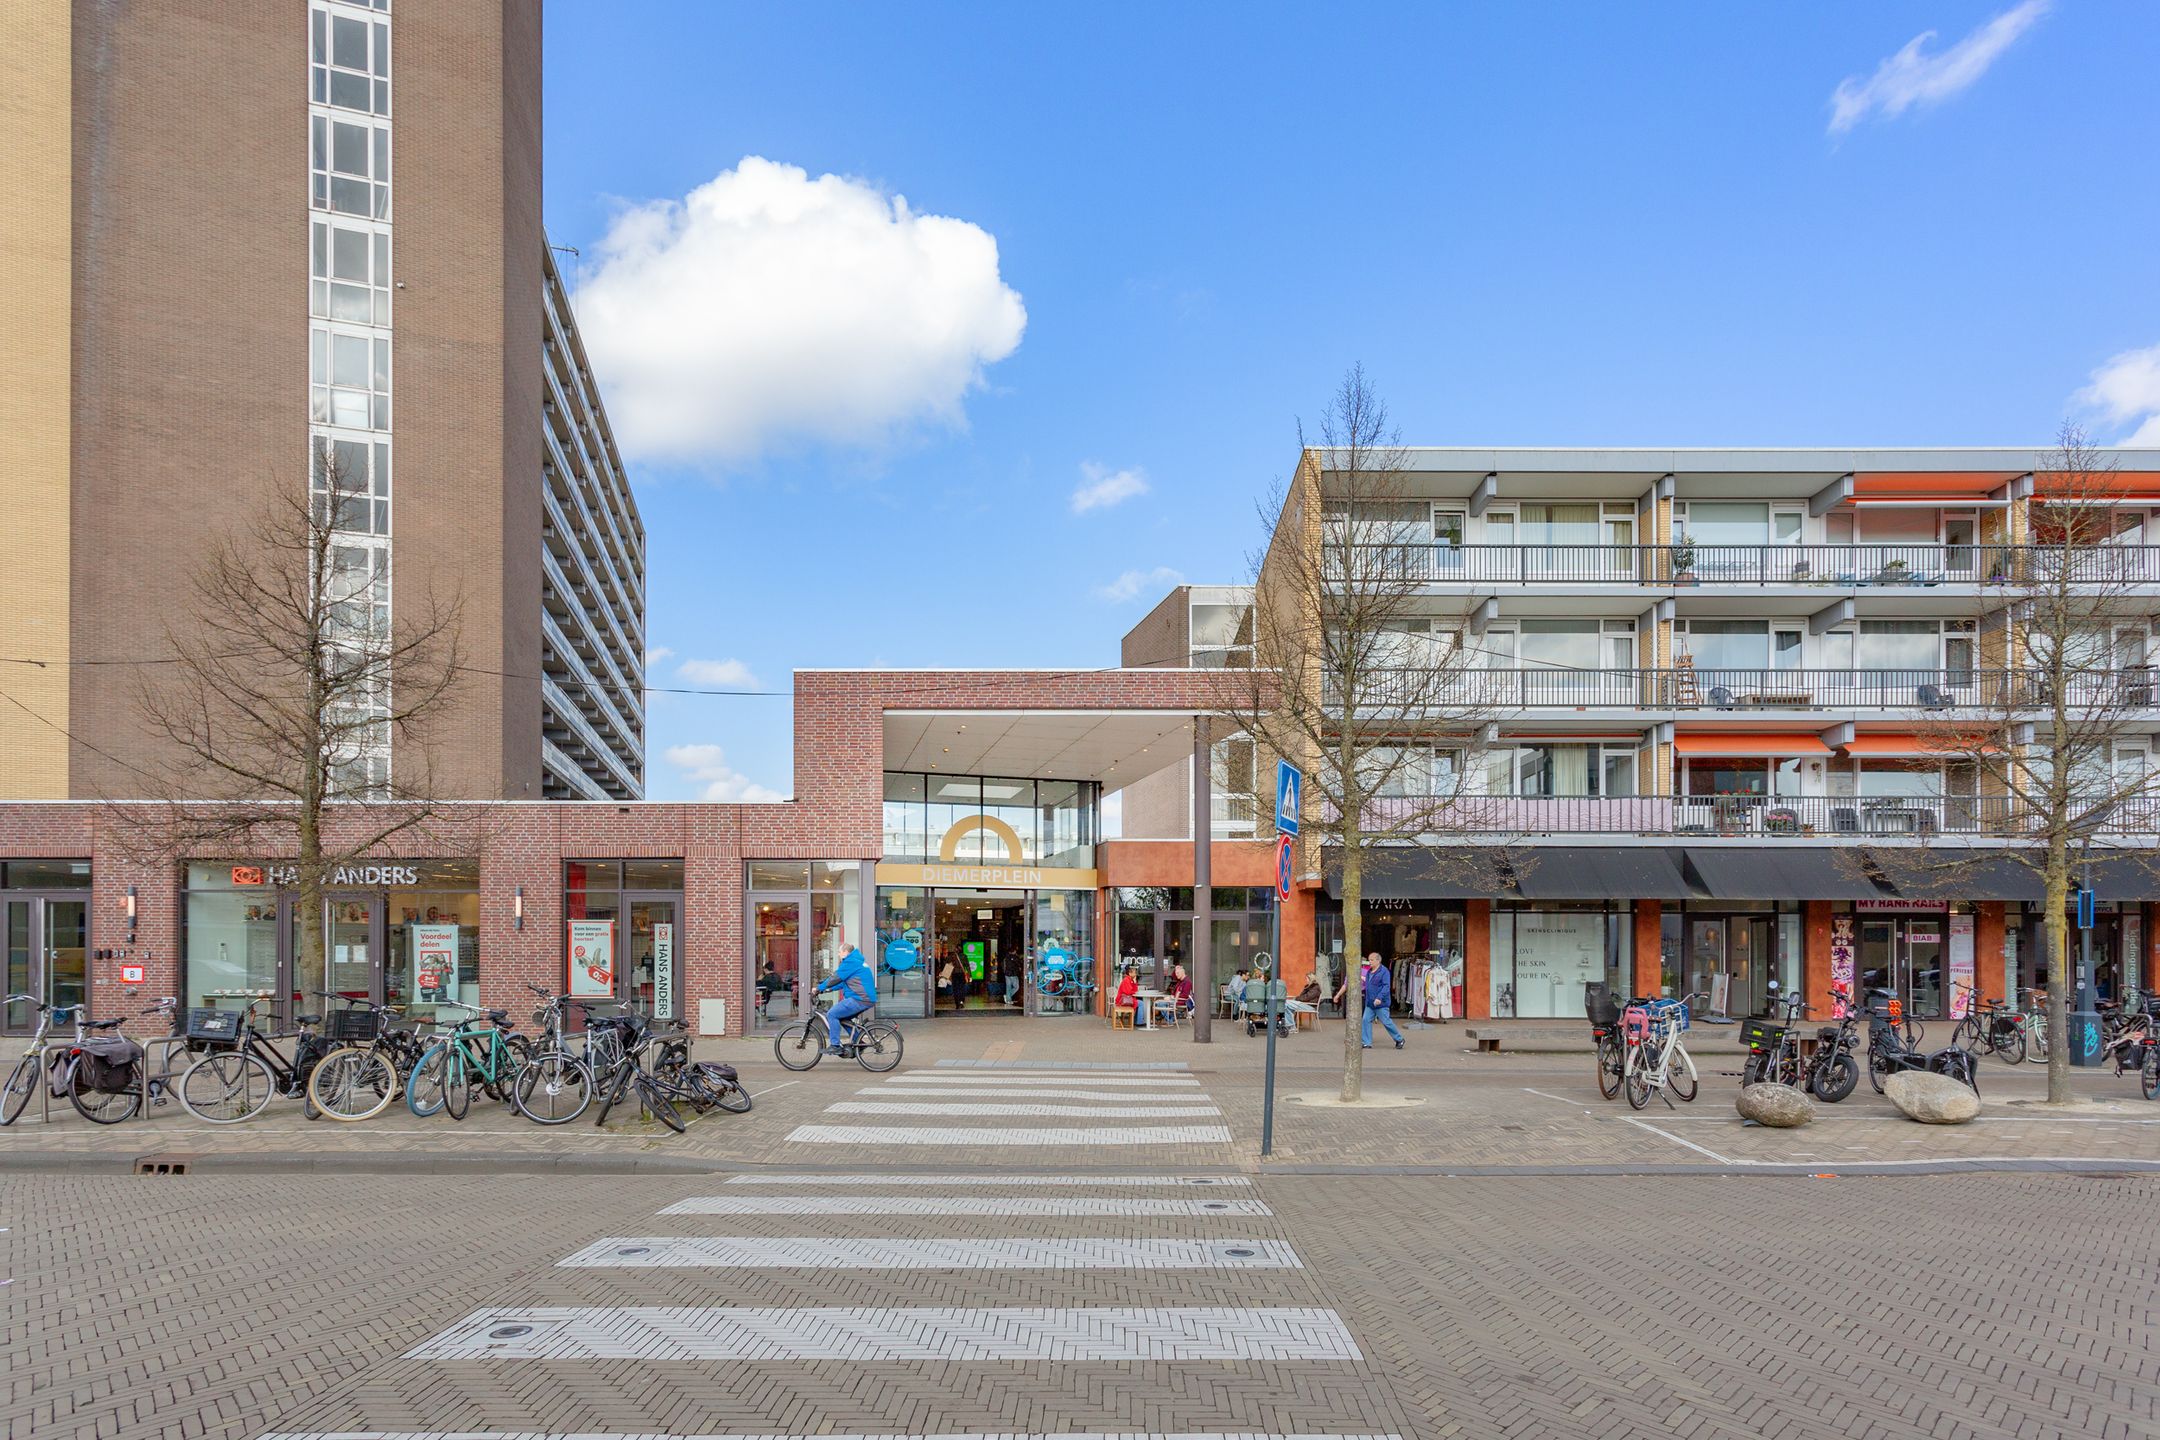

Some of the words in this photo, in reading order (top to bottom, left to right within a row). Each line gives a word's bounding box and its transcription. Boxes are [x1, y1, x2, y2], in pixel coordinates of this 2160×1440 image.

[268, 866, 326, 885] HA
[333, 866, 418, 885] ANDERS
[923, 866, 1041, 884] DIEMERPLEIN
[1368, 897, 1413, 910] YARA
[1858, 899, 1877, 908] MY
[658, 944, 668, 973] HANS
[658, 975, 668, 1016] ANDERS
